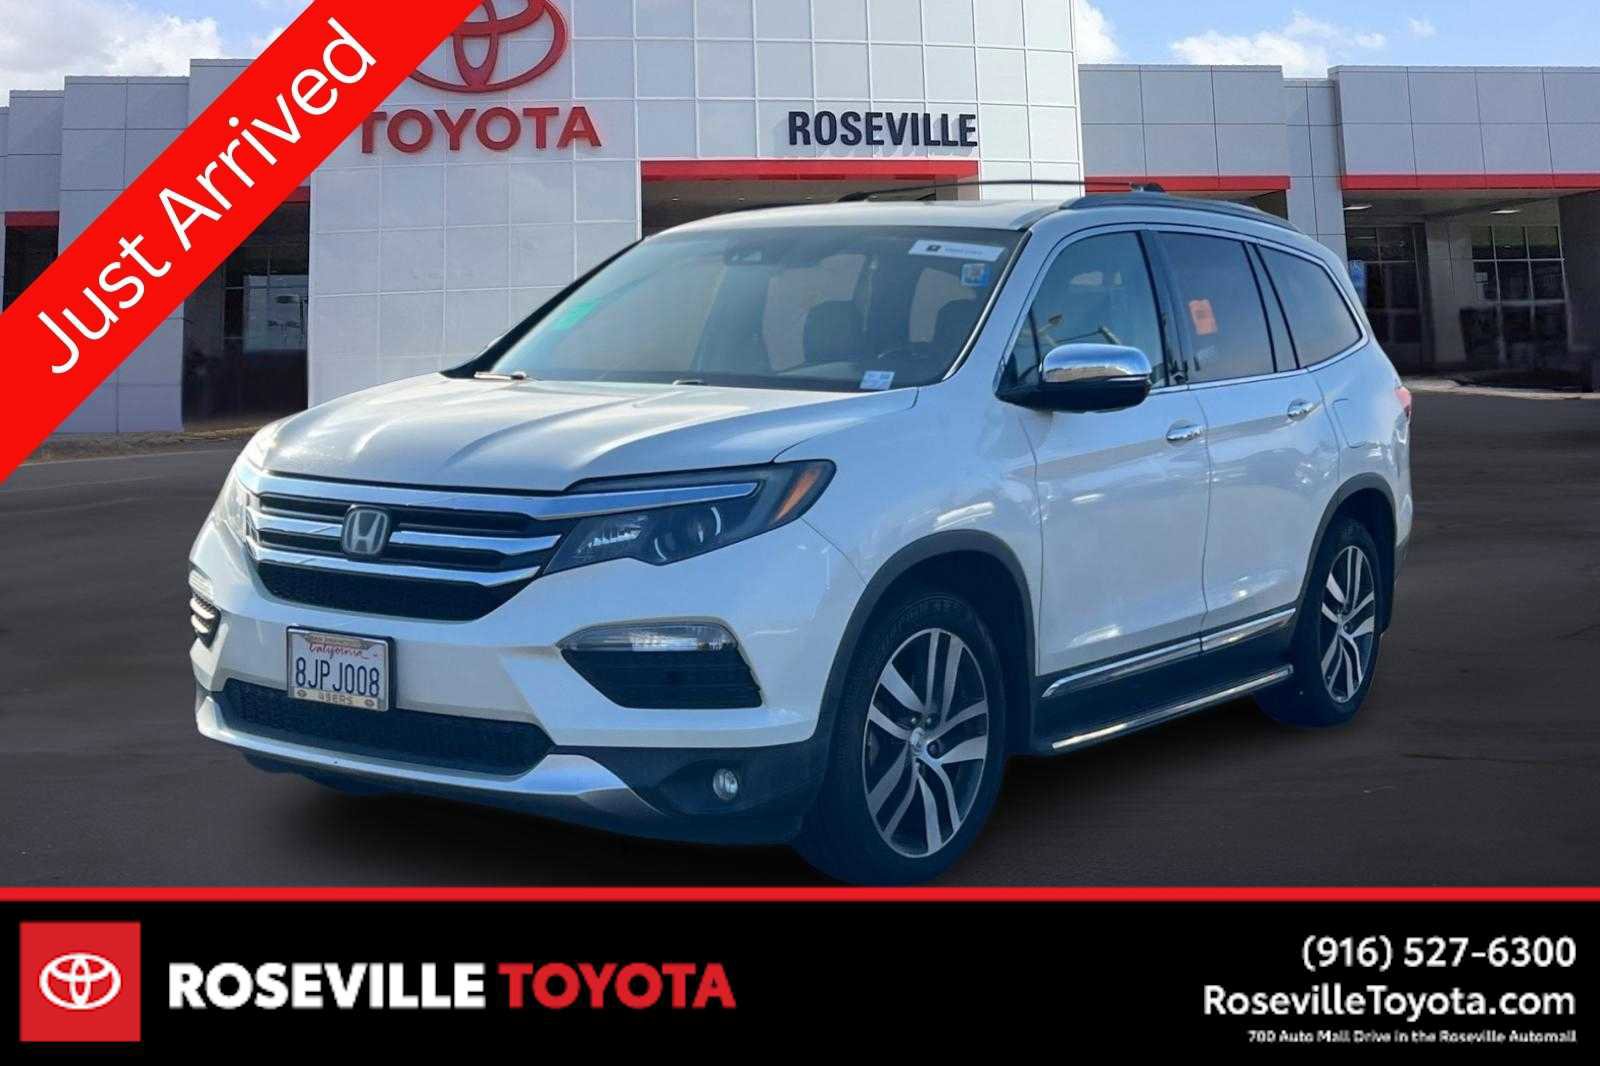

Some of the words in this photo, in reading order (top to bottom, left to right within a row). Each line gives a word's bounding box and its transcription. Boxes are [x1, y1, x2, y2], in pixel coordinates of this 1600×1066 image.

[361, 105, 602, 154] TOYOTA
[789, 111, 978, 147] ROSEVILLE
[296, 657, 380, 698] 8JPJ008
